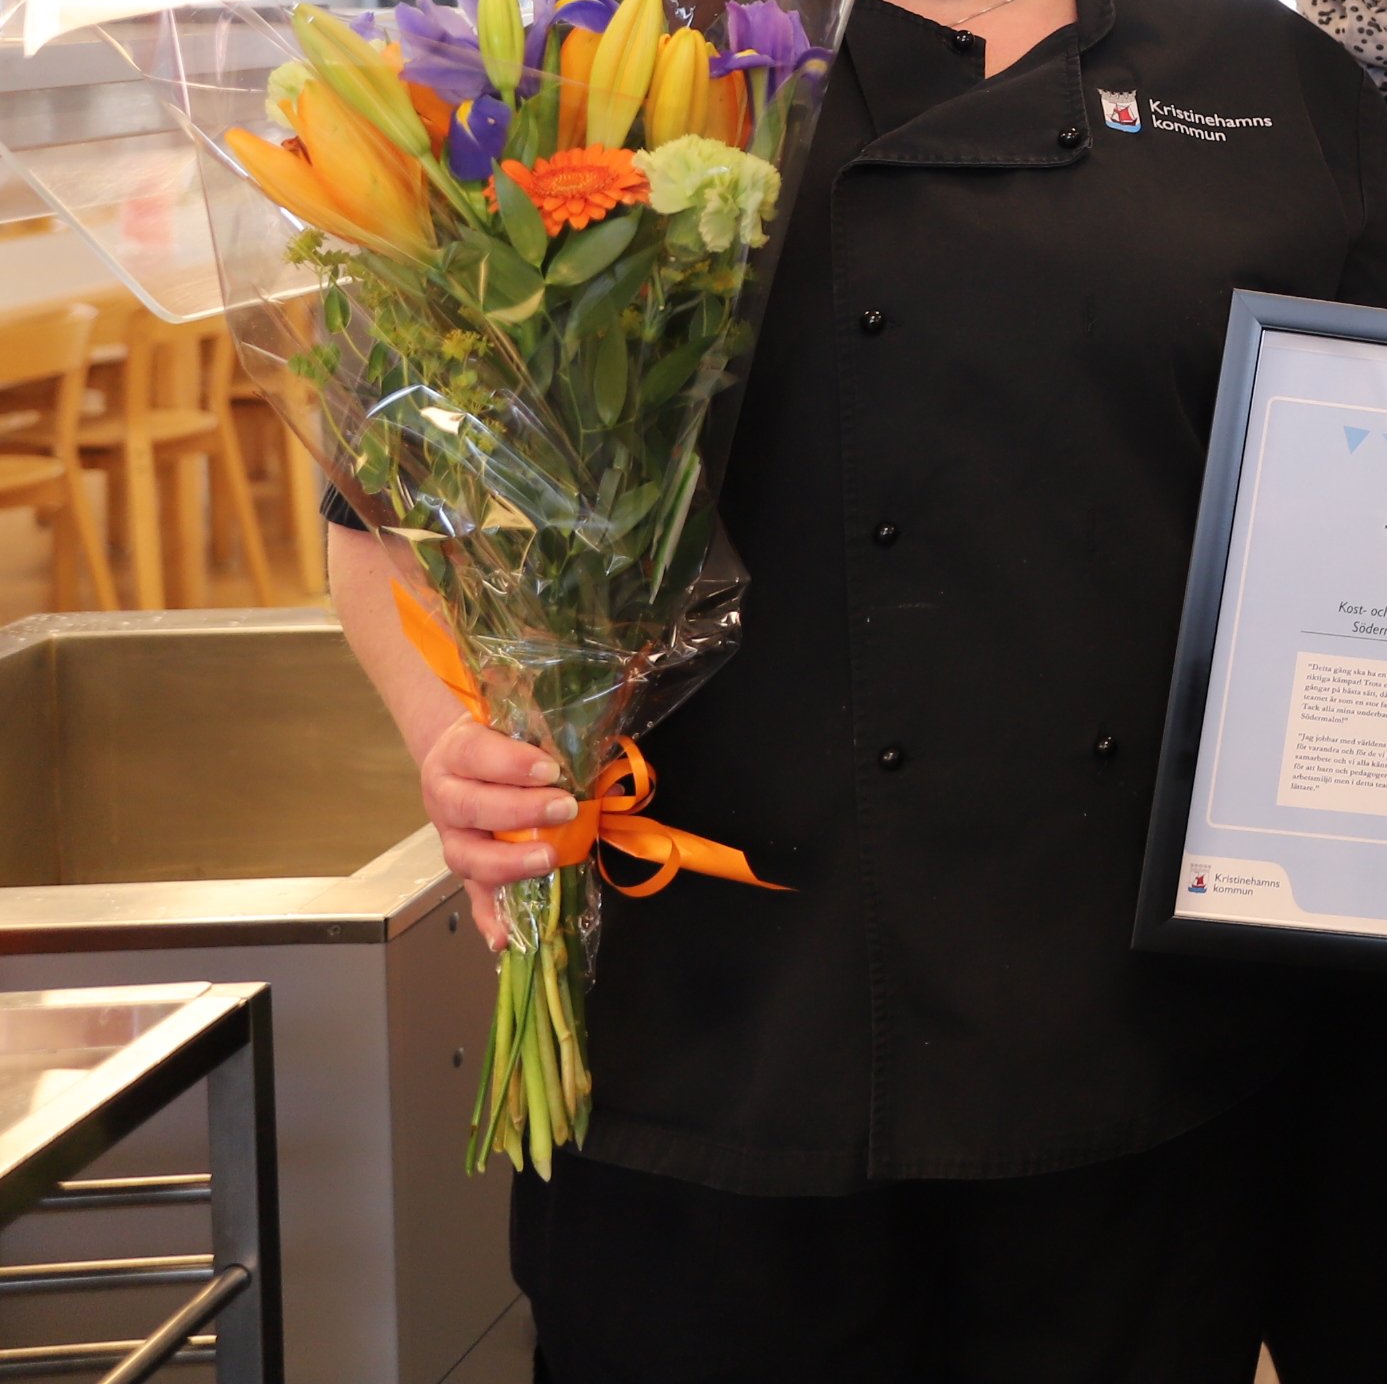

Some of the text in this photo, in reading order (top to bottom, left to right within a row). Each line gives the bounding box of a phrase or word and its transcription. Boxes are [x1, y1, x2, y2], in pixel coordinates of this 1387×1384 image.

[1149, 98, 1273, 128] Kristinehamns
[1152, 115, 1227, 142] kommun
[1338, 601, 1367, 616] Kost-
[1333, 666, 1352, 676] gång
[1353, 668, 1366, 676] ska
[1367, 669, 1376, 677] ha
[1363, 679, 1382, 687] Trots
[1331, 686, 1341, 694] på
[1342, 687, 1361, 695] bästa
[1303, 703, 1320, 711] Tack
[1316, 765, 1334, 773] barn
[1355, 779, 1374, 787] detta
[1214, 873, 1280, 888] Kristinehamns
[1213, 884, 1253, 895] kommun
